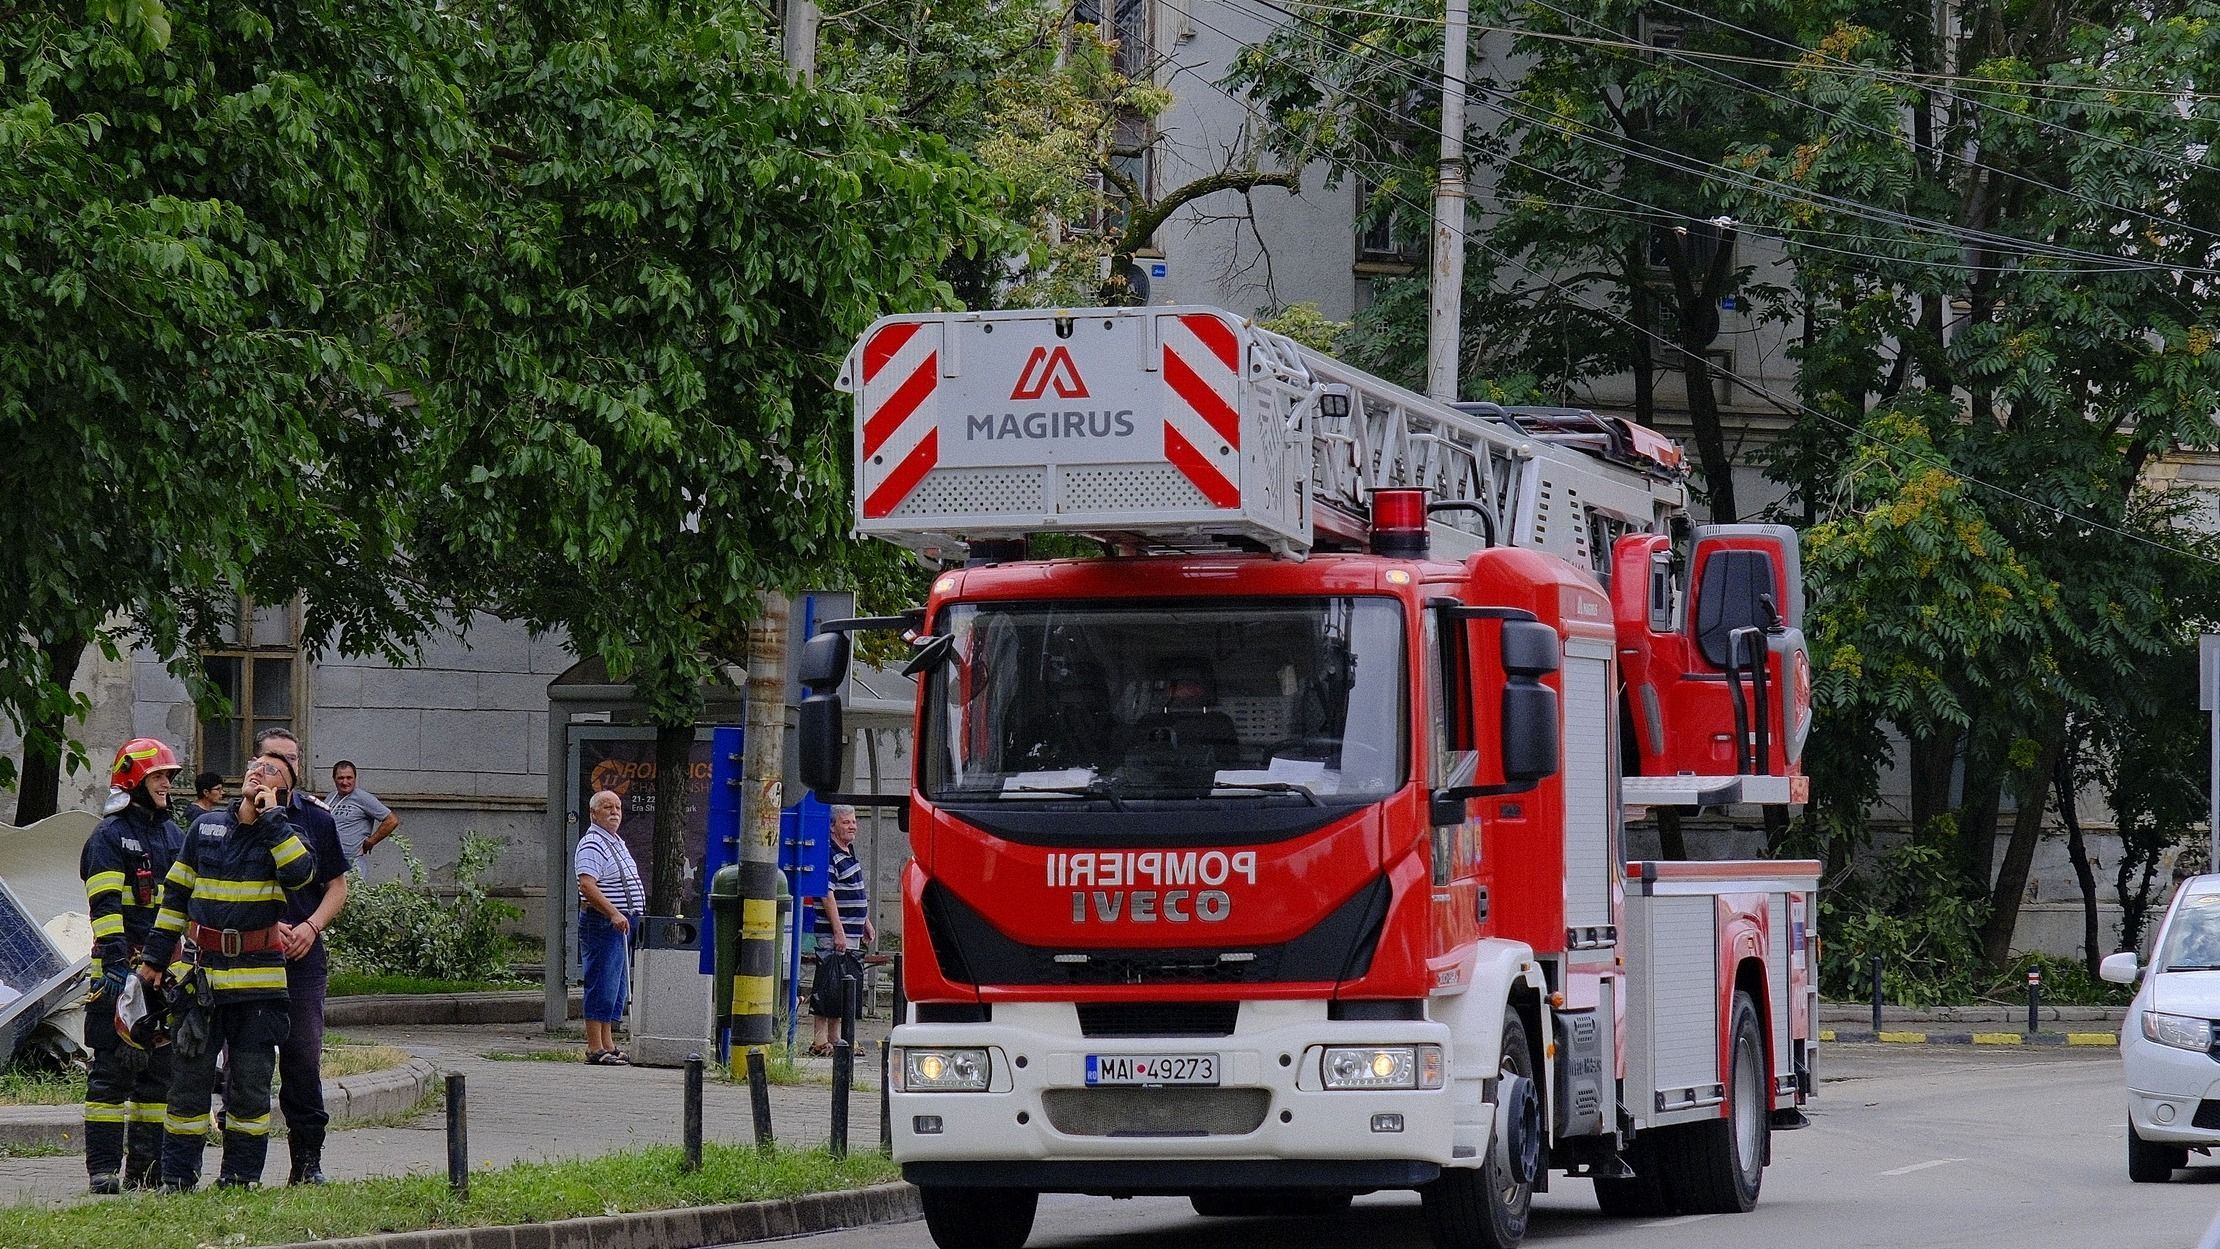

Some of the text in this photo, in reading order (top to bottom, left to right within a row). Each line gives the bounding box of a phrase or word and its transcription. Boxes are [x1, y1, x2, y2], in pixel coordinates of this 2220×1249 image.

[967, 410, 1134, 441] MAGIRUS
[632, 804, 644, 812] Era
[1072, 890, 1231, 923] IVECO
[1087, 1058, 1213, 1080] RO MAI 49273
